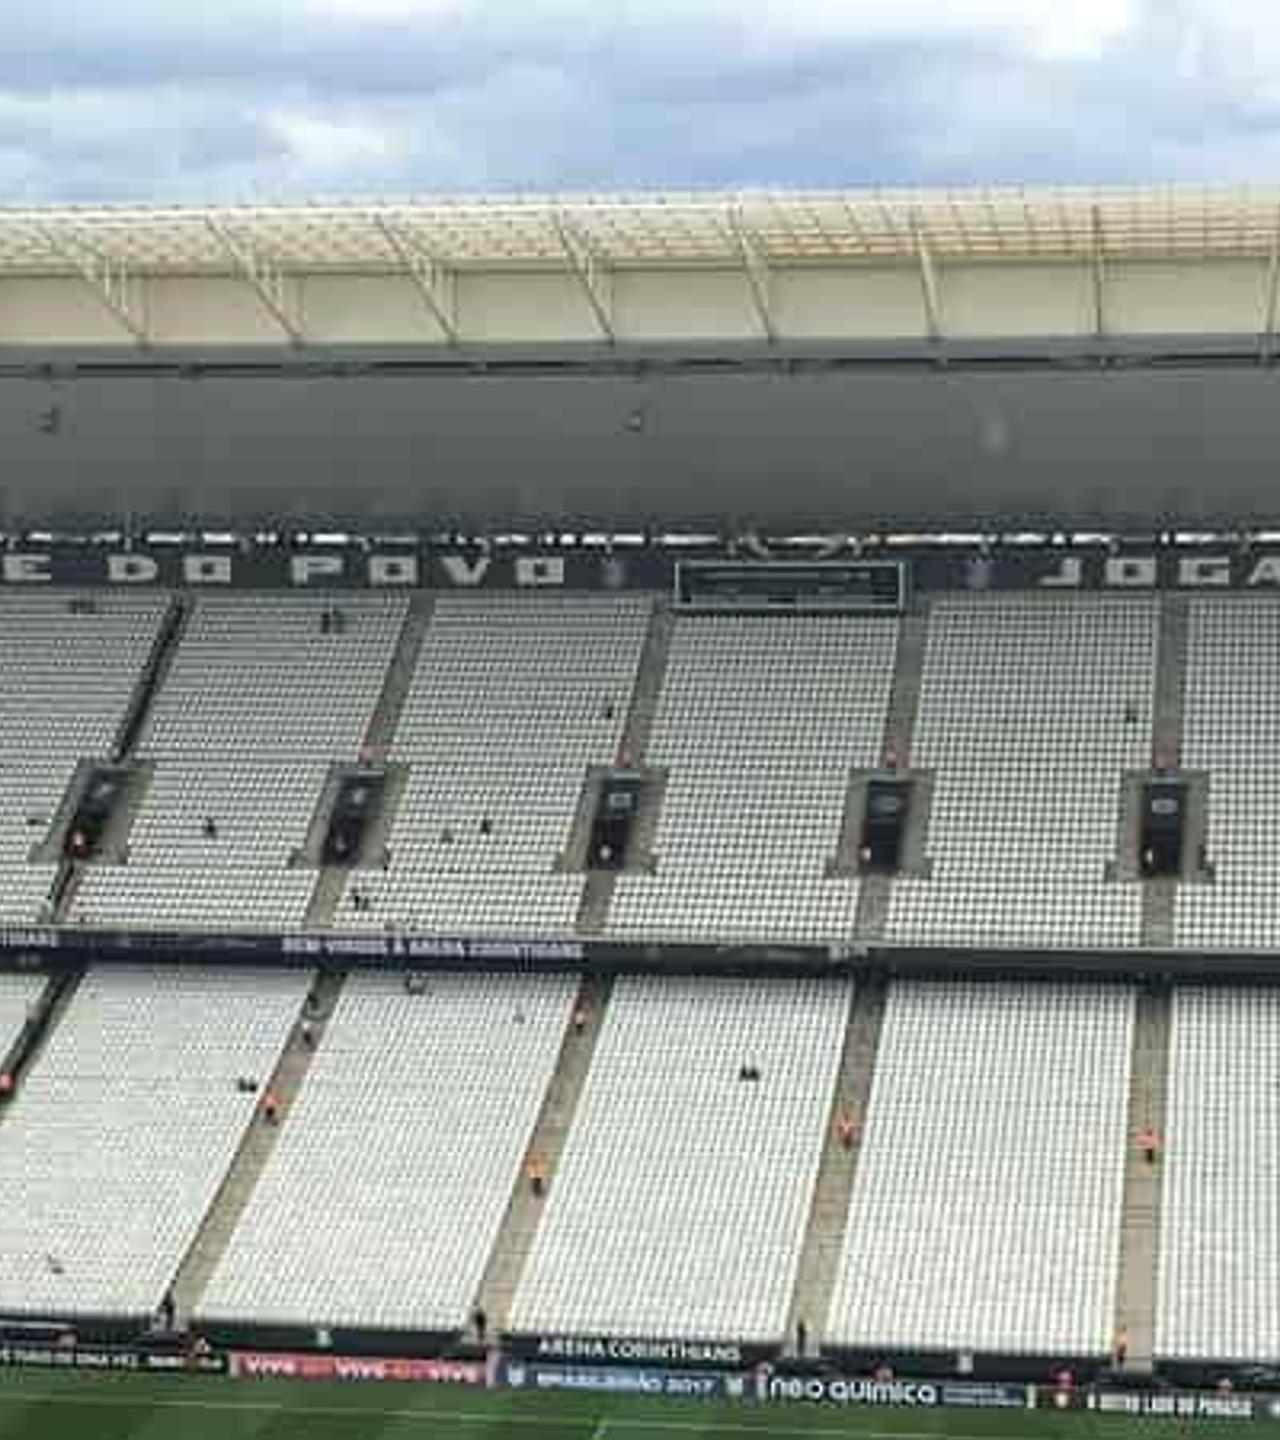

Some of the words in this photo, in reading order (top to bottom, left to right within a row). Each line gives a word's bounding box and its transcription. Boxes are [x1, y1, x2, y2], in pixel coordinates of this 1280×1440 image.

[109, 553, 233, 584] DO
[292, 555, 565, 586] POVO
[538, 1338, 604, 1358] ARENA
